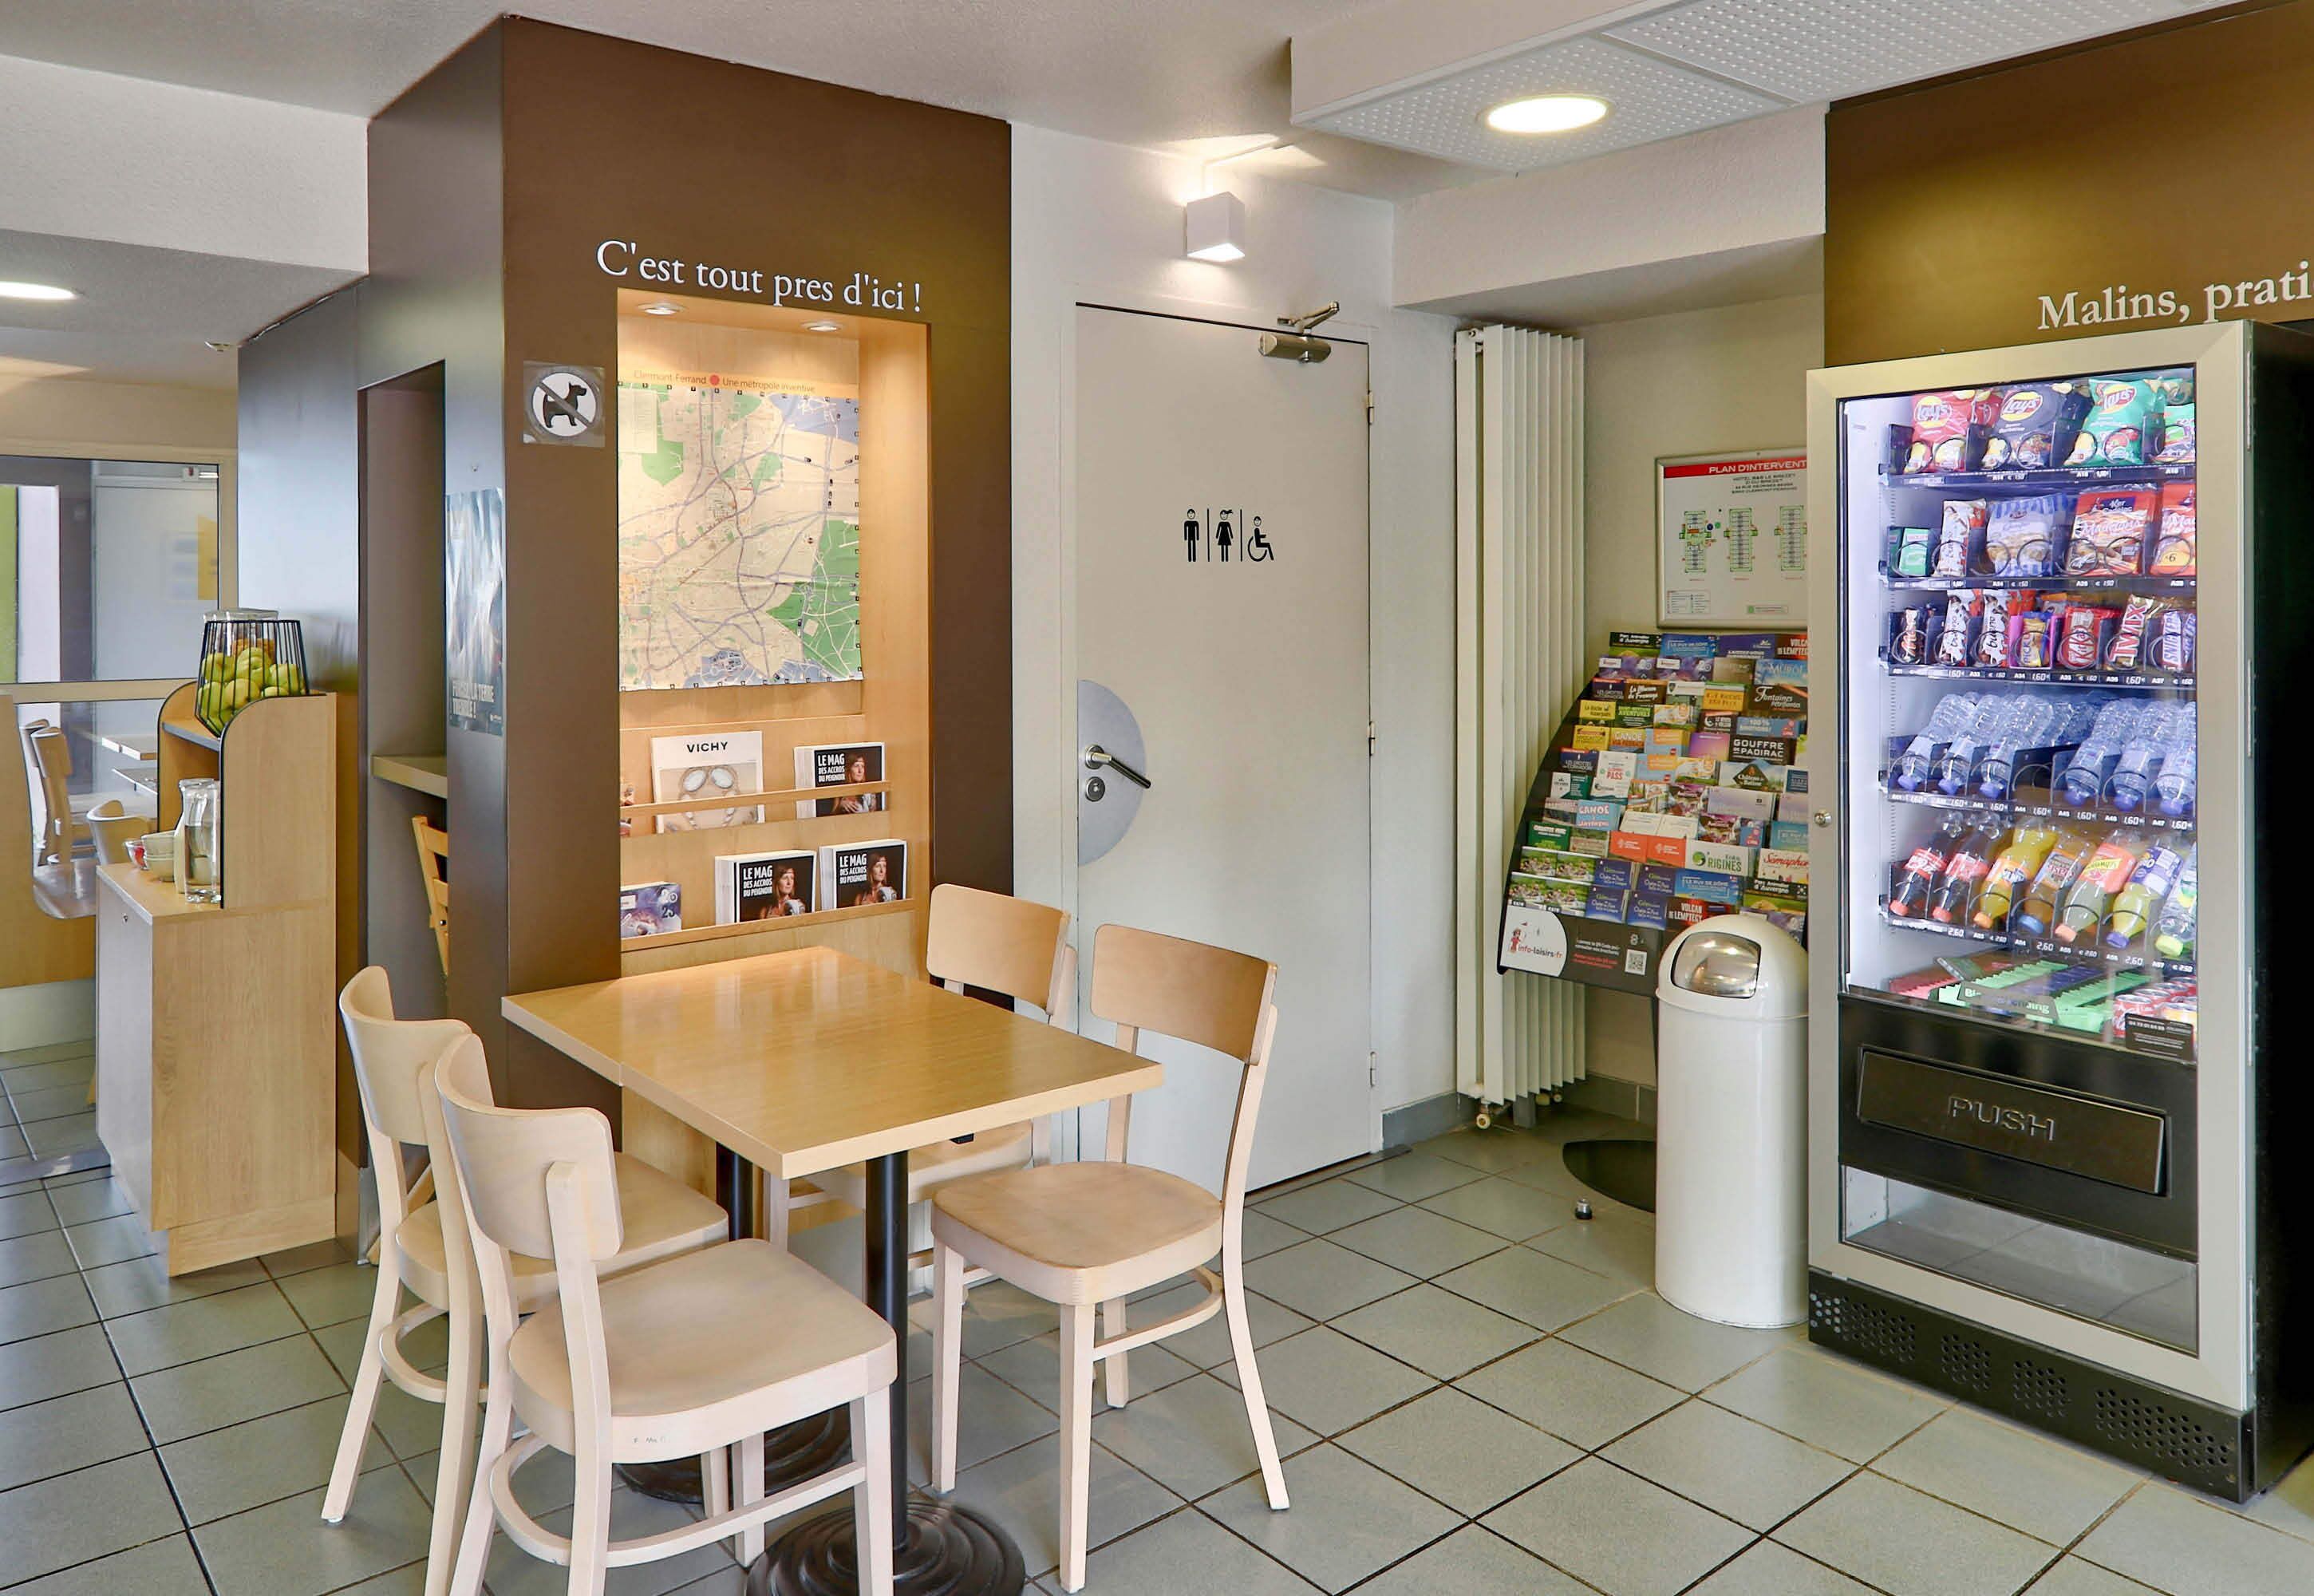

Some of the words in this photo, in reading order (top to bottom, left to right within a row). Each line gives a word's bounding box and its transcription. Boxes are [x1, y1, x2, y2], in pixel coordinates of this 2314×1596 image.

[596, 239, 685, 283] C'est
[696, 263, 763, 294] tout
[772, 274, 833, 306] pres
[843, 272, 905, 310] d'ici
[913, 282, 922, 313] !
[2038, 285, 2190, 330] Malins,
[2202, 260, 2314, 324] prati
[722, 376, 739, 387] Une
[2109, 603, 2149, 662] TWIX
[1790, 638, 1807, 647] VOLCA
[1754, 686, 1794, 702] Fontaines
[686, 741, 729, 754] VICHY
[1733, 739, 1784, 750] GOUFFRE
[817, 755, 827, 767] LE
[827, 753, 845, 766] MAG
[1741, 749, 1783, 758] PADIRAC
[827, 765, 845, 775] ACCROS
[1606, 771, 1623, 780] PASS
[839, 855, 849, 867] LE
[850, 853, 867, 867] MAG
[743, 867, 752, 879] LE
[753, 866, 773, 879] MAG
[839, 867, 849, 876] DES
[850, 865, 867, 875] ACCROS
[743, 880, 753, 889] DES
[753, 878, 772, 888] ACCROS
[1947, 1095, 2056, 1142] PUSH
